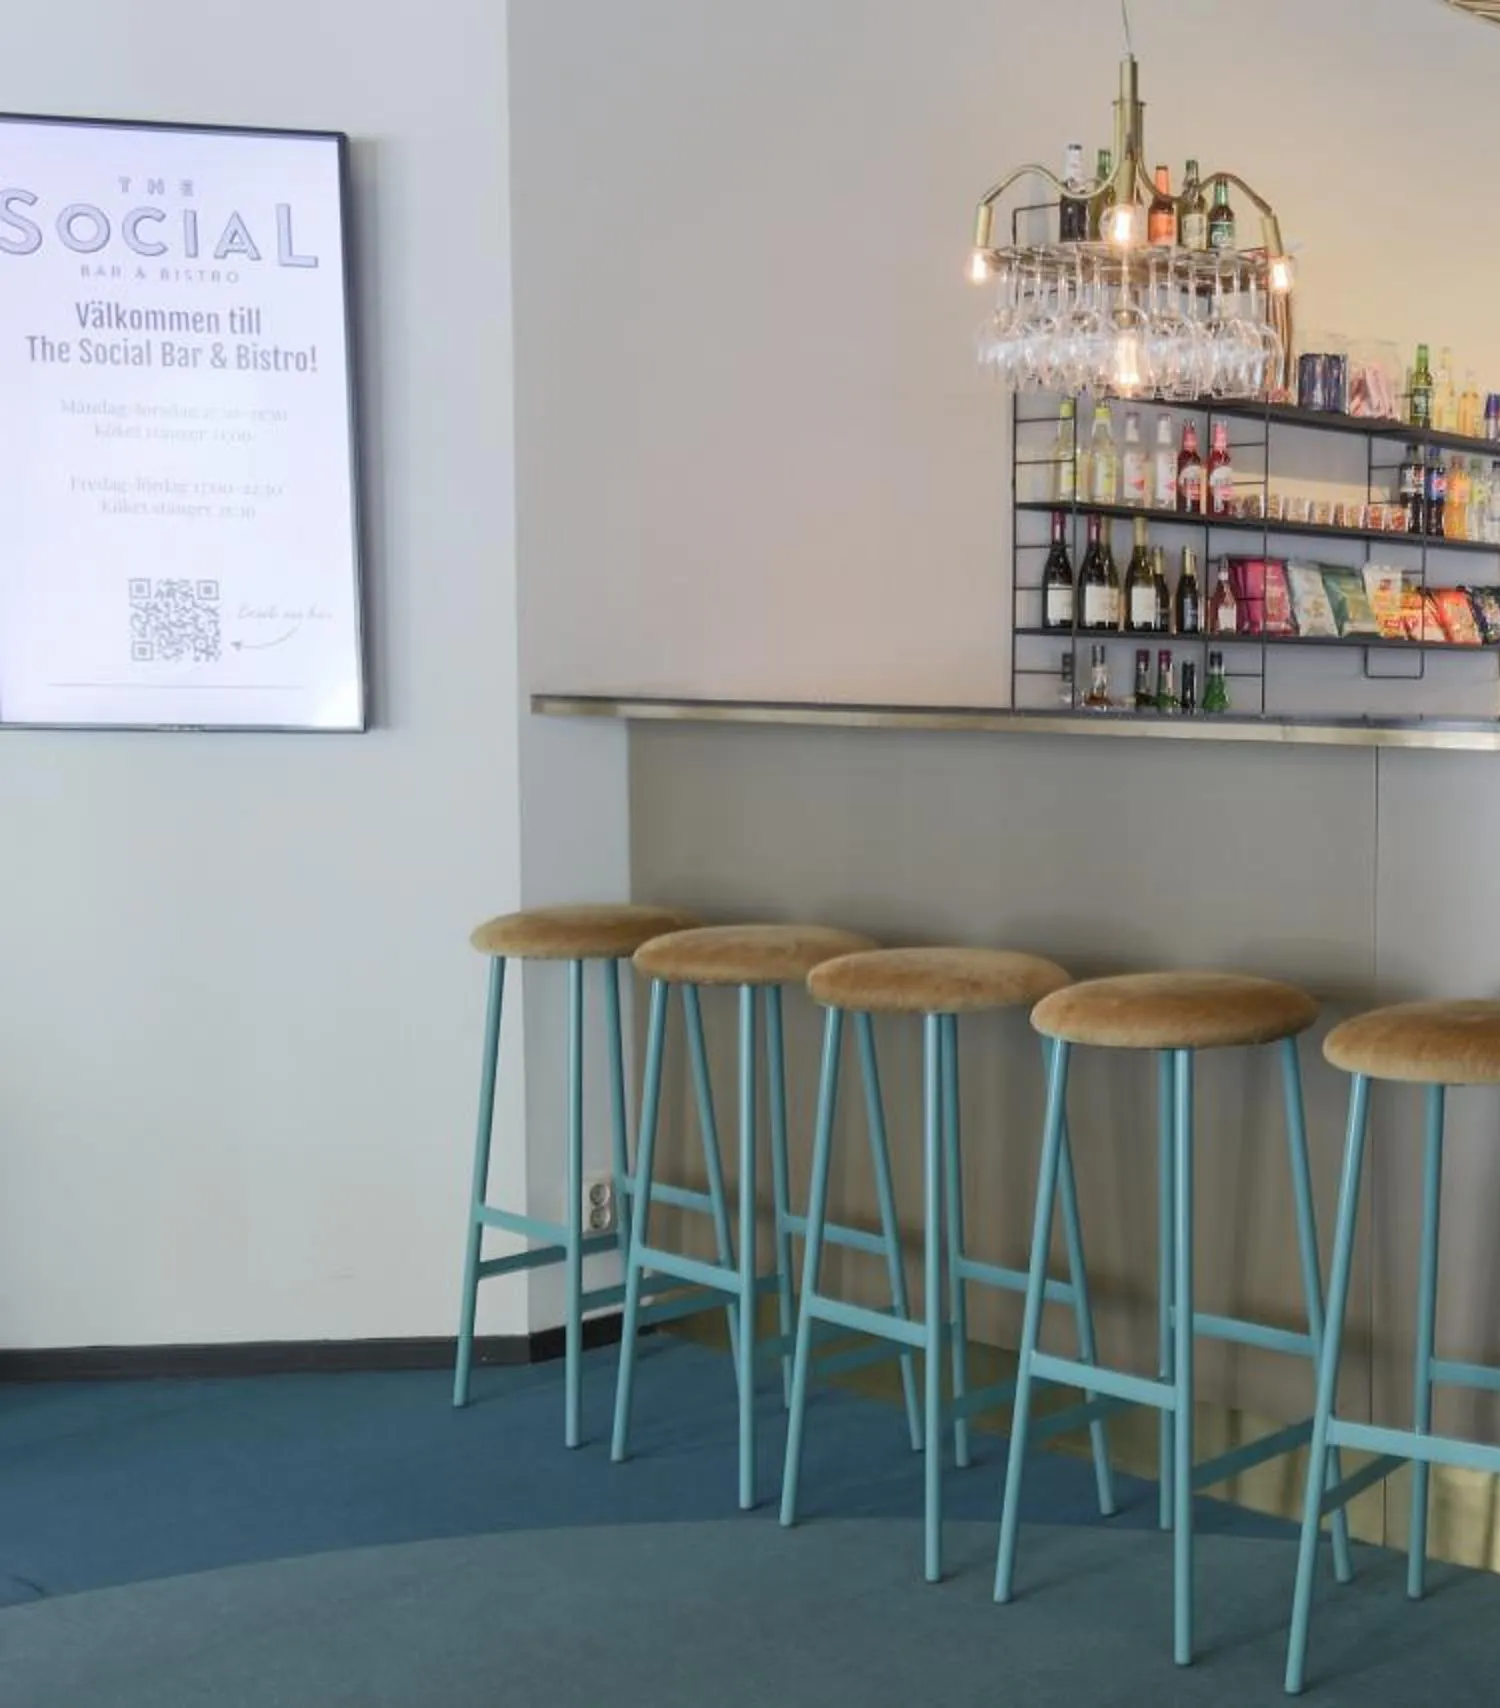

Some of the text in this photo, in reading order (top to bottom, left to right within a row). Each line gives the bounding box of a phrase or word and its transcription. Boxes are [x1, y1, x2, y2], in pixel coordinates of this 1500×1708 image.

[118, 176, 195, 197] THE
[0, 188, 319, 268] SOCIAL
[75, 301, 262, 336] Välkommen till
[25, 335, 319, 373] The Social Bar & Bistro!
